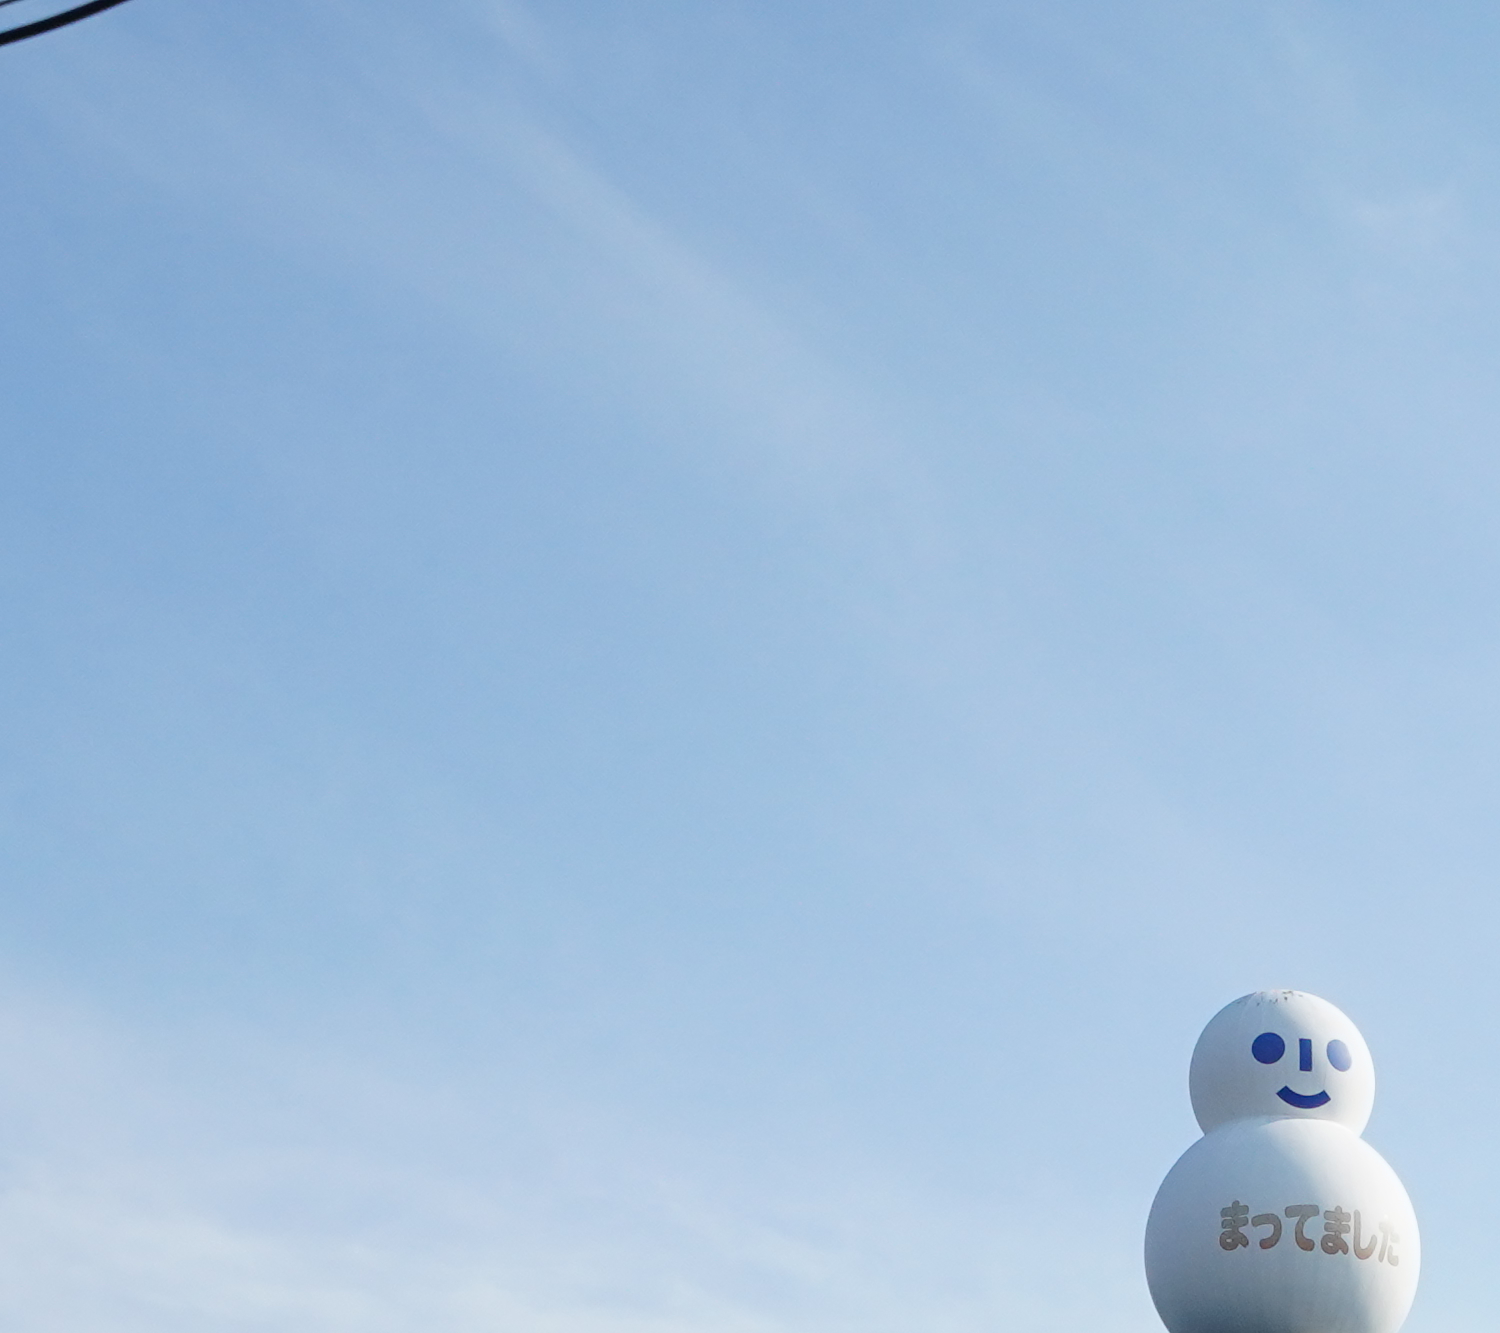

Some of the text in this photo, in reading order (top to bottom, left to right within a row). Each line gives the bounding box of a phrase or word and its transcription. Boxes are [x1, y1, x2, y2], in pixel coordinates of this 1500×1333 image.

[1219, 1199, 1402, 1266] まってました
